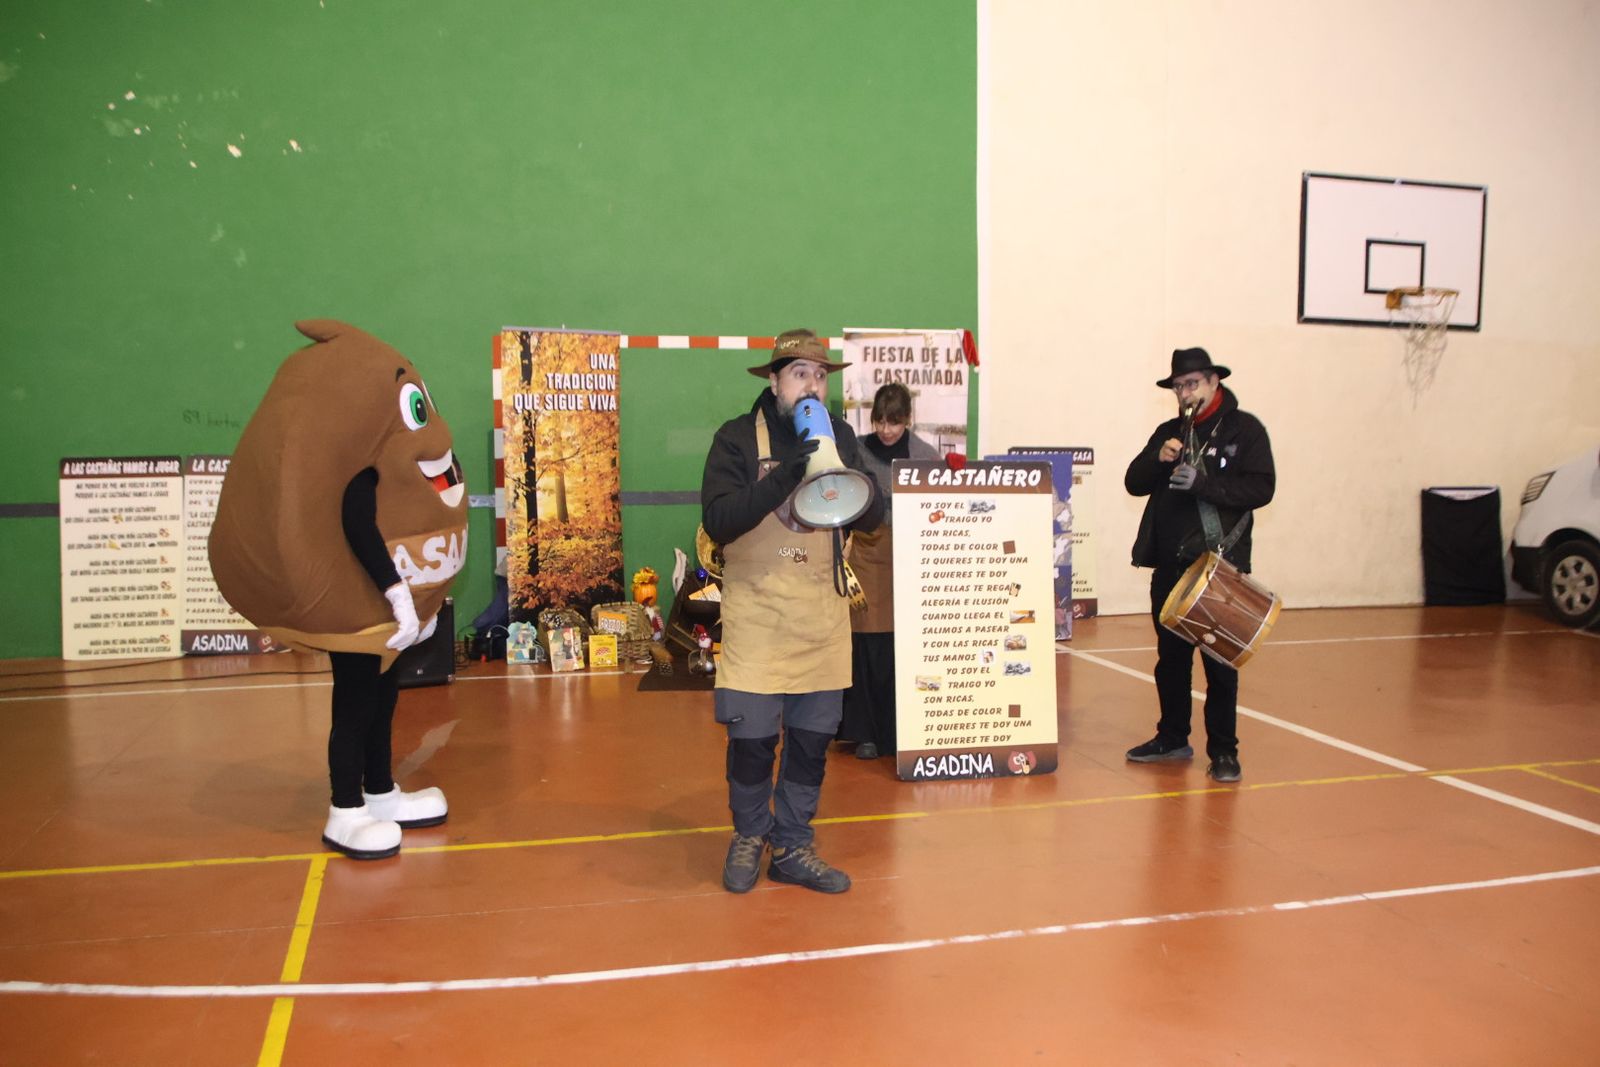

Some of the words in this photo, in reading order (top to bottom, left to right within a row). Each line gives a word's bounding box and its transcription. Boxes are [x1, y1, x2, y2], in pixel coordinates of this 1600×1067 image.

[863, 346, 914, 363] FIESTA
[920, 347, 939, 363] DE
[946, 348, 964, 364] LA
[589, 353, 616, 370] UNA
[873, 365, 963, 385] CASTAÑADA
[546, 373, 616, 390] TRADICION
[513, 393, 540, 414] QUE
[544, 393, 584, 411] SIGUE
[588, 394, 617, 411] VIVA
[1073, 451, 1092, 462] CASA
[63, 462, 70, 475] A
[71, 461, 85, 475] LAS
[85, 459, 122, 475] CASTAÑAS
[148, 461, 154, 474] A
[192, 459, 205, 473] LA
[208, 459, 231, 473] CAS
[898, 468, 921, 486] EL
[927, 465, 1042, 488] CASTAÑERO
[921, 543, 950, 551] TODAS
[393, 530, 468, 585] ASA
[920, 557, 930, 565] SI
[932, 557, 972, 565] QUIERES
[921, 571, 930, 579] SI
[933, 571, 973, 579] QUIERES
[921, 585, 940, 593] CON
[921, 598, 961, 606] ALEGRÍA
[972, 597, 1009, 605] ILUSIÓN
[963, 612, 991, 620] LLEGA
[921, 626, 964, 634] SALIMOS
[975, 625, 1010, 633] PASEAR
[192, 634, 249, 651] ASADINA
[972, 639, 999, 647] RICAS
[942, 653, 976, 661] MANOS
[961, 667, 978, 675] SOY
[948, 681, 981, 689] TRAIGO
[923, 696, 943, 704] SON
[972, 707, 1002, 715] COLOR
[924, 724, 934, 732] SI
[936, 722, 976, 731] QUIERES
[992, 721, 1011, 729] DOY
[925, 738, 934, 746] SI
[937, 736, 977, 745] QUIERES
[913, 752, 994, 777] ASADINA
